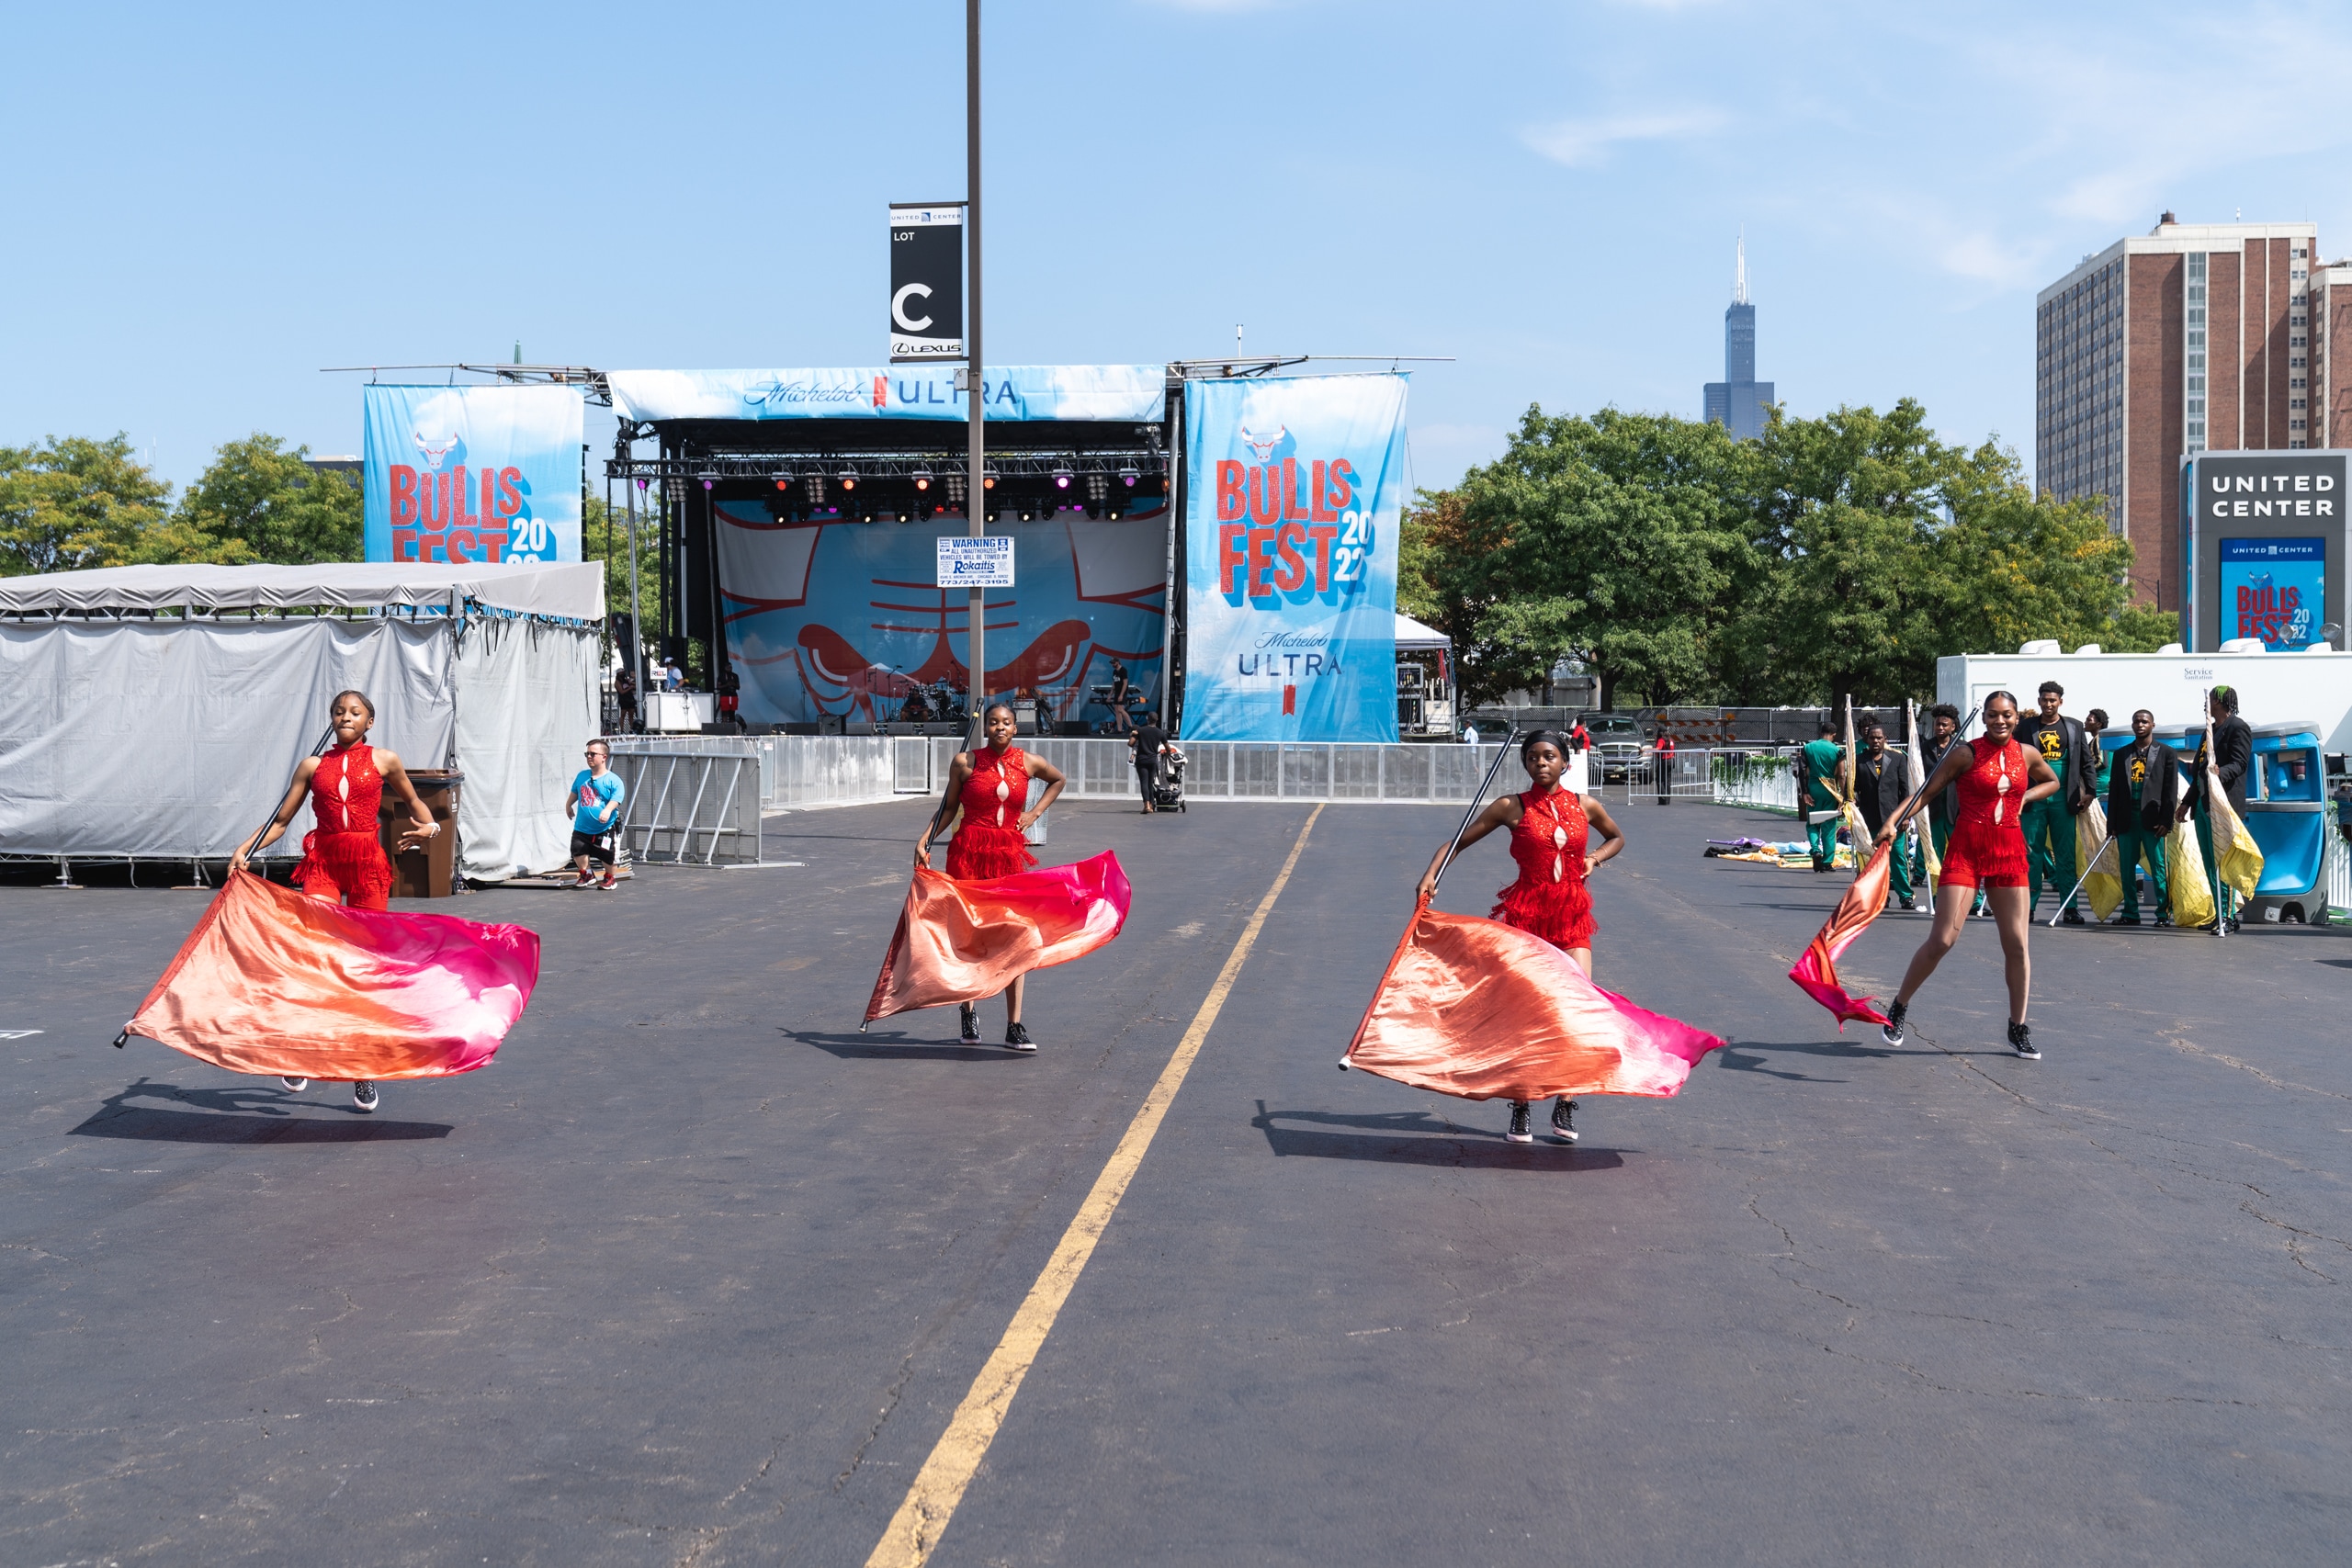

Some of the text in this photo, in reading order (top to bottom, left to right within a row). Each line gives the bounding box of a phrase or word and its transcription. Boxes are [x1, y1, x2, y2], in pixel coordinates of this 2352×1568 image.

[894, 231, 915, 242] LOT
[891, 282, 933, 332] C
[911, 344, 962, 353] LEXUS
[744, 380, 861, 405] Michelob
[1216, 457, 1351, 525] BULLS
[2212, 475, 2335, 493] UNITED
[390, 464, 522, 531] BULLS
[2212, 500, 2335, 517] CENTER
[512, 517, 547, 551] 20
[1341, 511, 1373, 545] 20
[952, 538, 996, 547] WARNING
[953, 560, 995, 573] Rokaitis
[1219, 522, 1338, 597] FEST
[1334, 547, 1365, 581] 22
[2237, 585, 2299, 615] BULLS
[2294, 608, 2310, 624] 20
[1254, 631, 1328, 649] Michelob
[1238, 653, 1342, 677] ULTRA
[2184, 667, 2213, 675] Service
